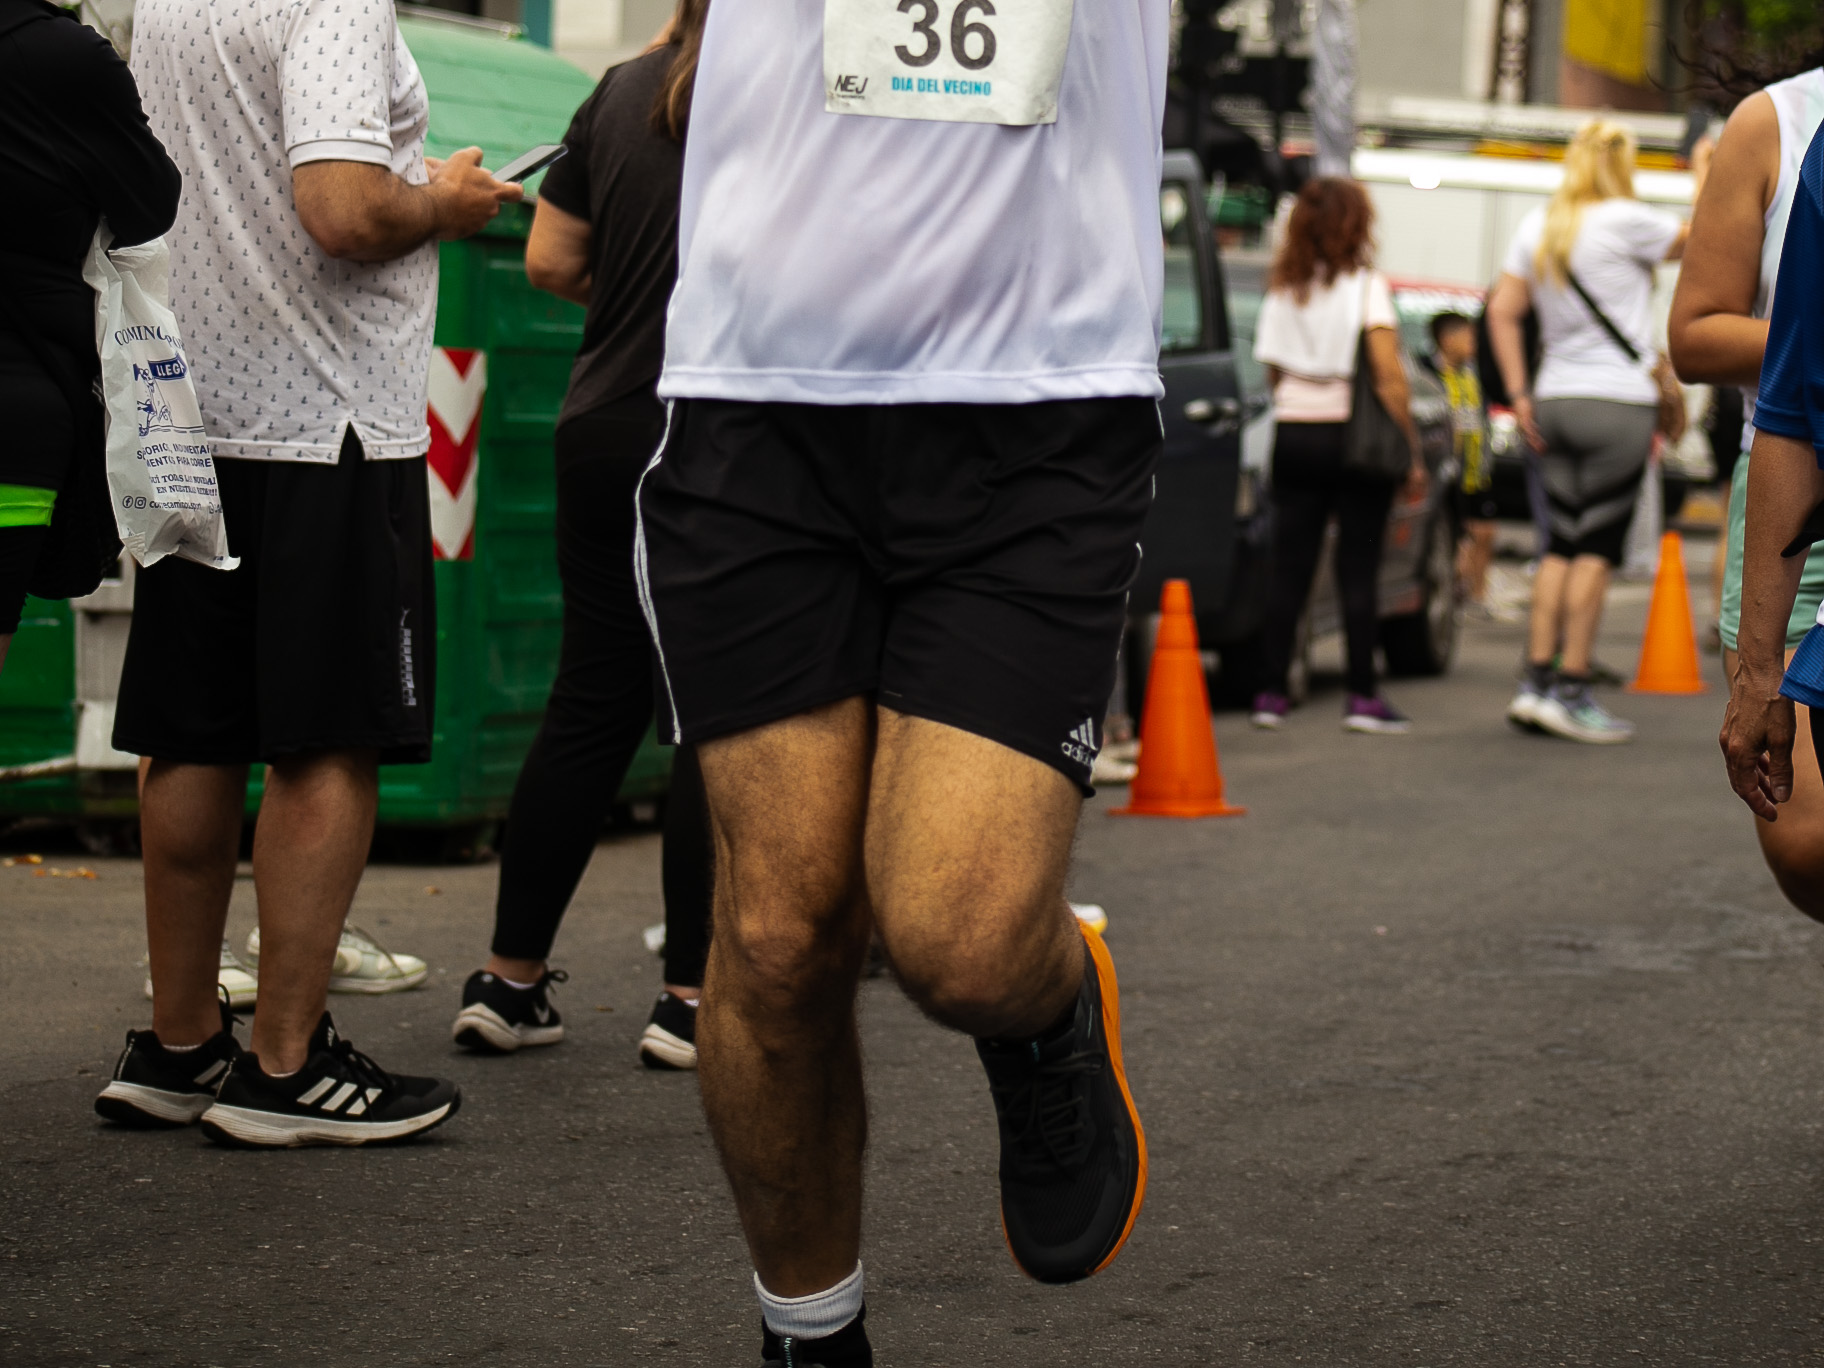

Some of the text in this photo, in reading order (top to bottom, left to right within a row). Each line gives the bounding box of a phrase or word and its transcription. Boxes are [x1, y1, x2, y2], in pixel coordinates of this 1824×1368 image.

[891, 76, 992, 97] DIA DEL VECINO
